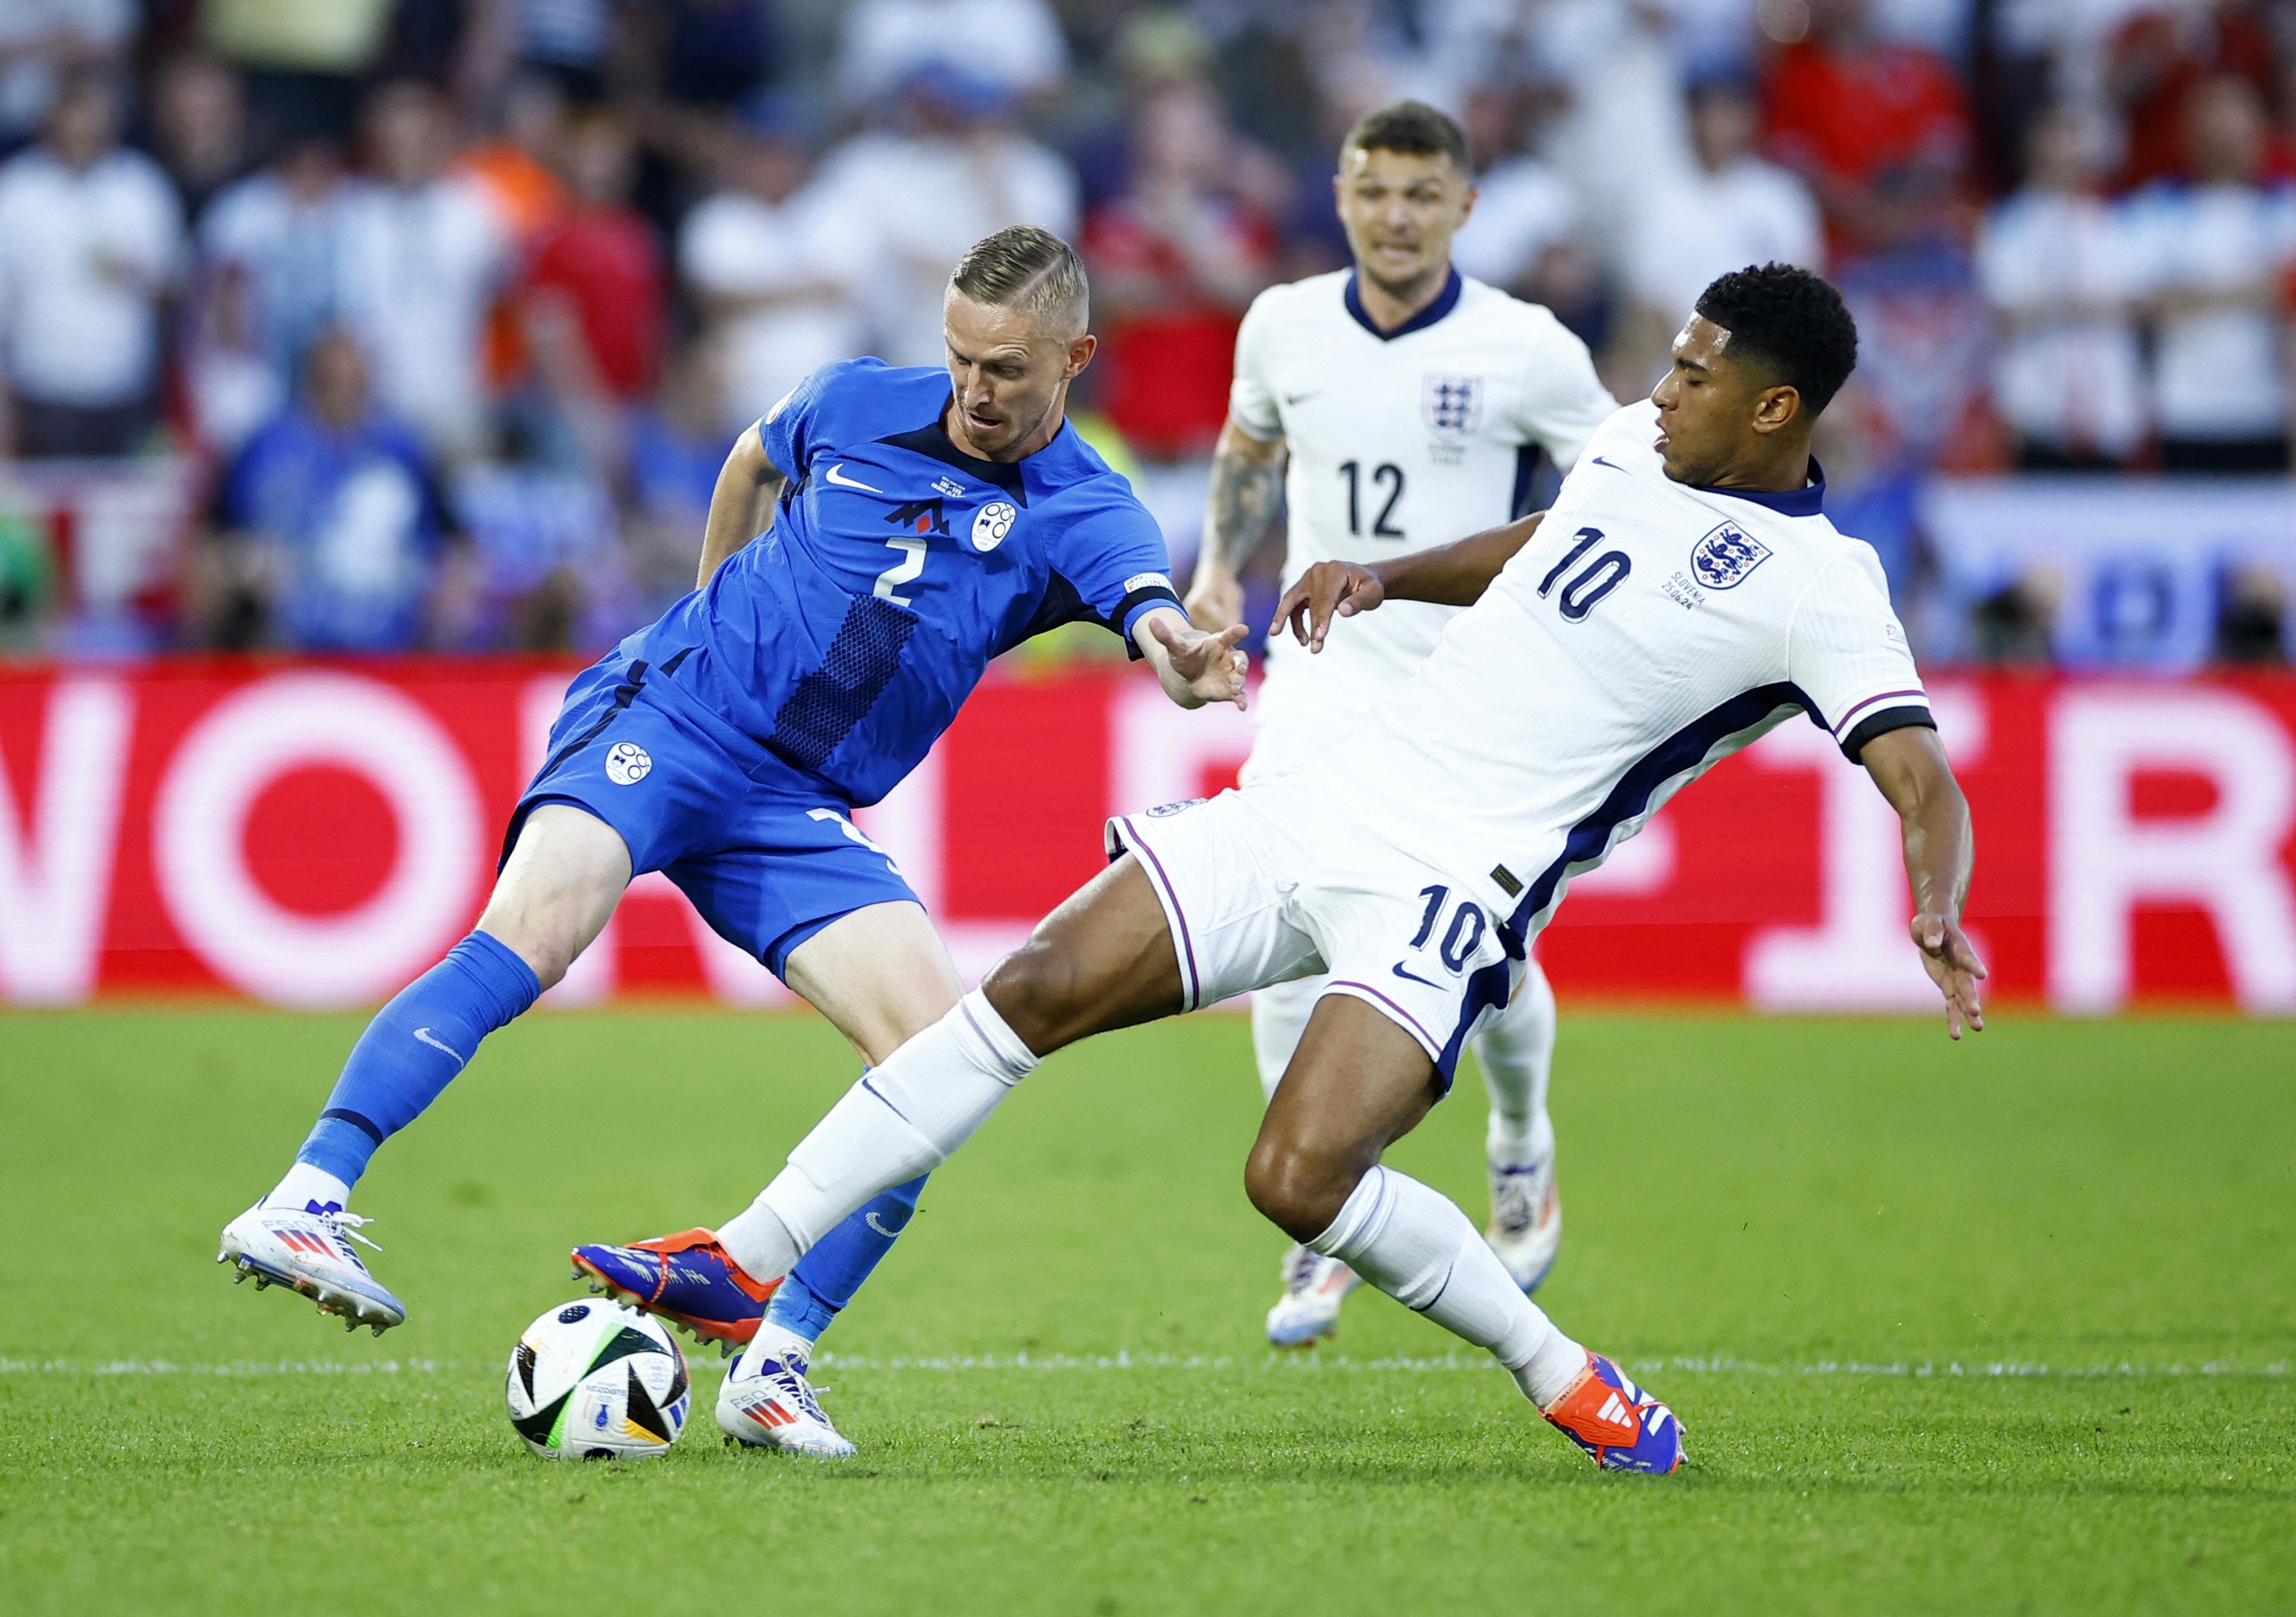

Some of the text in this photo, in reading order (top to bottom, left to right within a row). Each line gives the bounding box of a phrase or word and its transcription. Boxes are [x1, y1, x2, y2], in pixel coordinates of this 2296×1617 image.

[1338, 459, 1406, 540] 12
[872, 536, 927, 608] 2
[1536, 526, 1632, 624] 10
[1670, 571, 1707, 605] SLOVENIA
[1410, 884, 1486, 978] 10
[729, 1389, 768, 1409] F50
